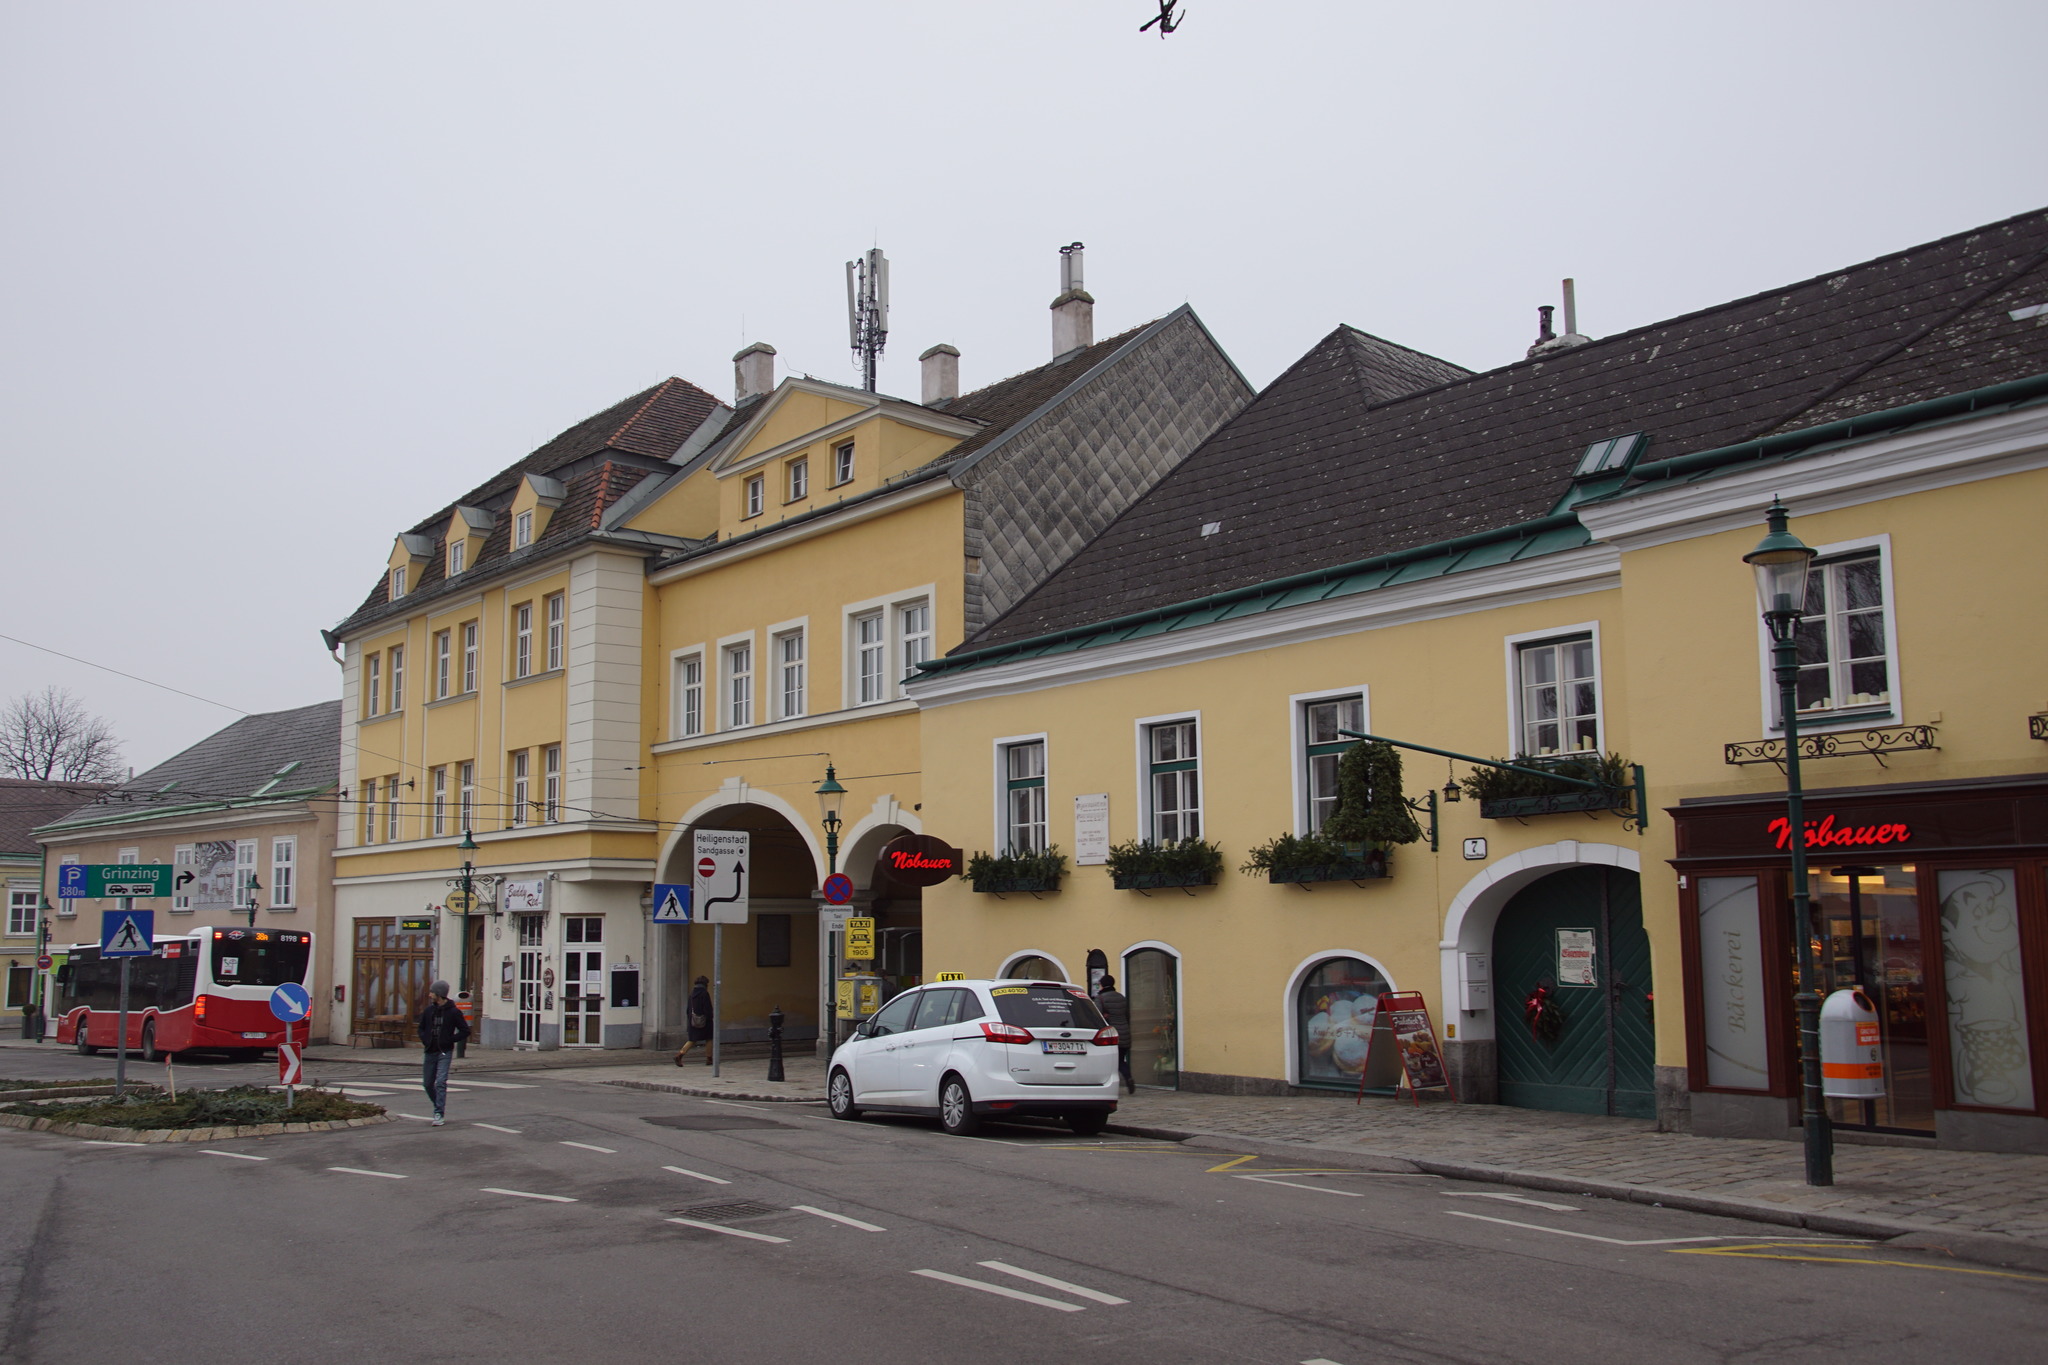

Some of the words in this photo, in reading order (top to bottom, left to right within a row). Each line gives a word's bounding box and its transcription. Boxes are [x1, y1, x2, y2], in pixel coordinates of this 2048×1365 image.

[1767, 814, 1911, 850] Nöbauer
[696, 833, 748, 845] Heiligenstadt
[697, 845, 735, 856] Sandgasse
[1472, 840, 1478, 853] 7
[891, 851, 952, 869] Nöbauer
[101, 867, 160, 881] Grinzing
[505, 883, 528, 901] Buddy
[831, 922, 844, 930] Ende
[280, 935, 298, 943] 8198
[942, 973, 963, 981] TAXI
[1721, 929, 1746, 1034] Bäckerei
[1058, 1042, 1074, 1050] 3047
[1075, 1042, 1085, 1050] TX
